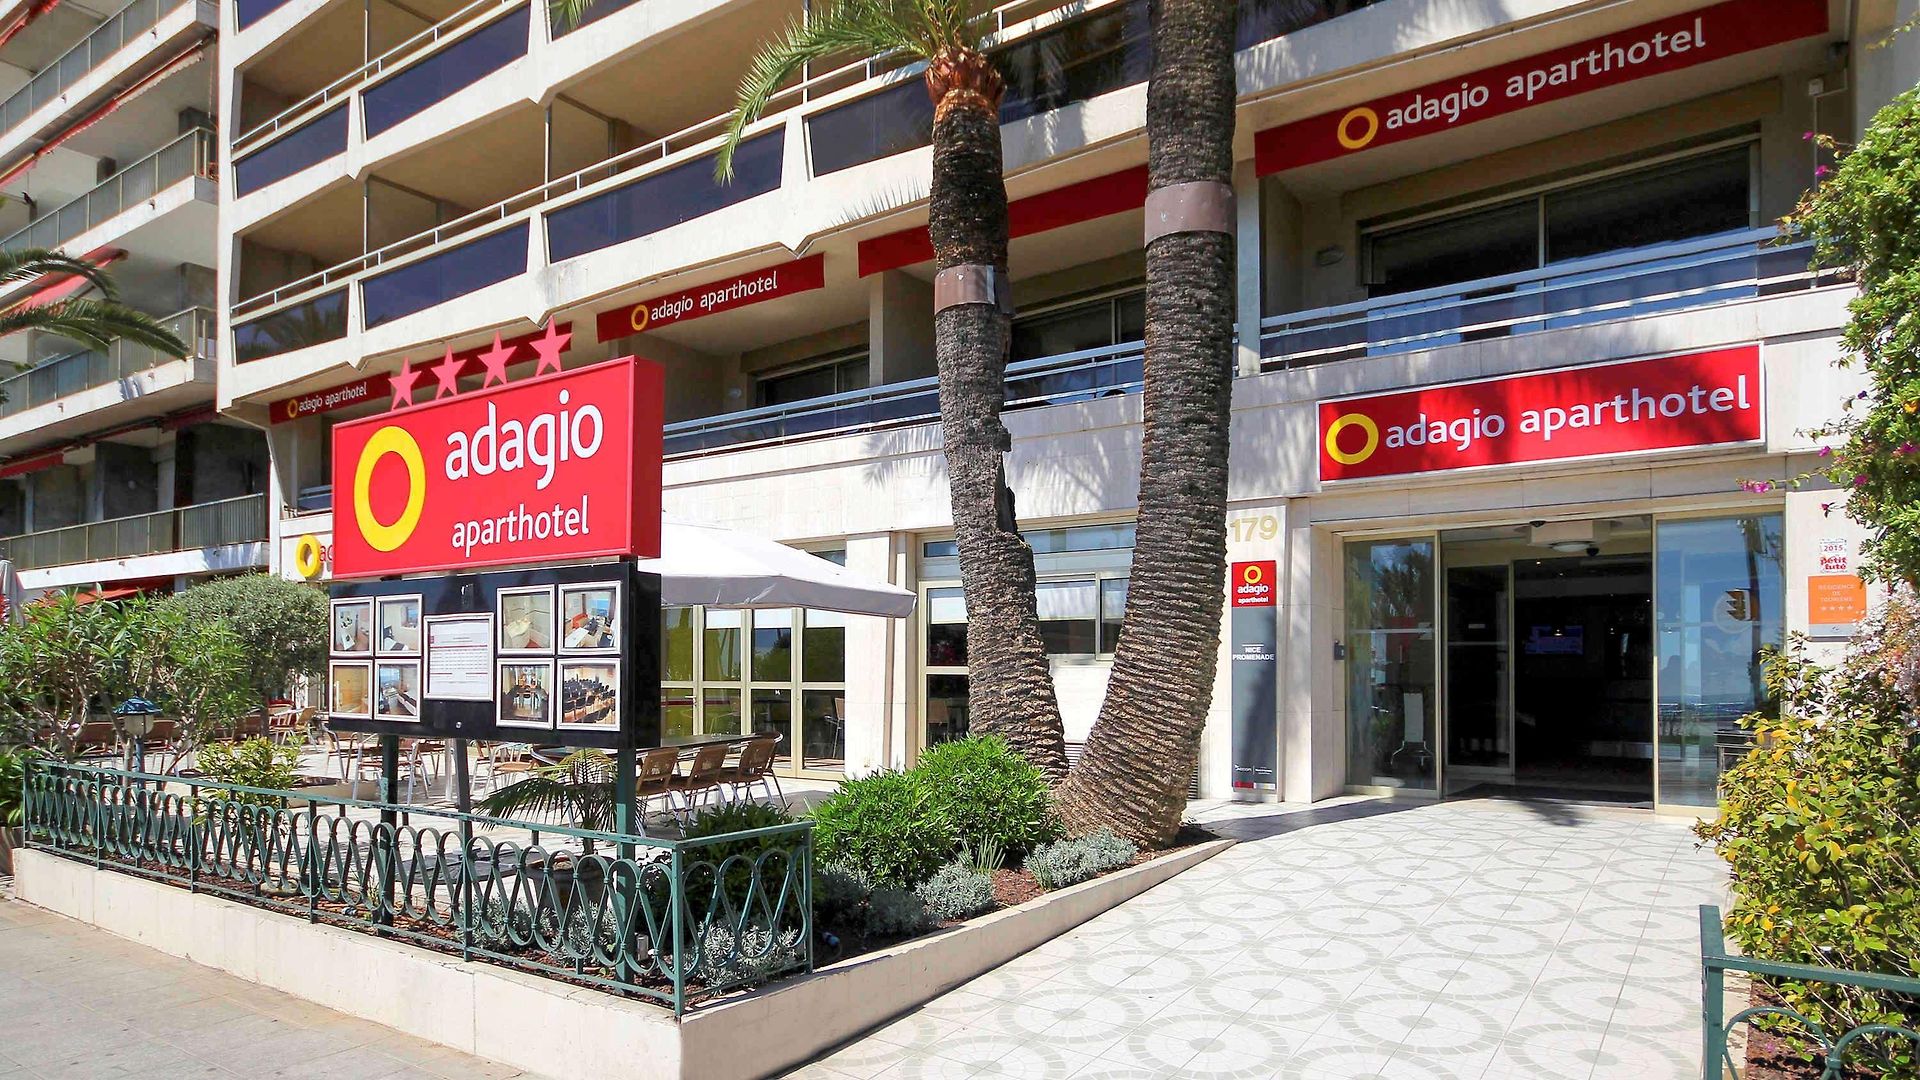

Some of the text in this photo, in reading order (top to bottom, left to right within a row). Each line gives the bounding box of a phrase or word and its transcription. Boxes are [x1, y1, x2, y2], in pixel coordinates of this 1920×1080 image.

[1386, 17, 1706, 130] adagio aparthotel
[651, 270, 778, 322] adagio aparthotel
[299, 381, 367, 413] adagio aparthotel
[1386, 374, 1751, 452] adagio aparthotel
[444, 389, 604, 490] adagio
[452, 494, 590, 558] aparthotel
[1230, 515, 1278, 543] 179
[1237, 583, 1269, 595] adagio
[1237, 596, 1269, 605] aparthotel
[1232, 653, 1275, 661] PROMENADE
